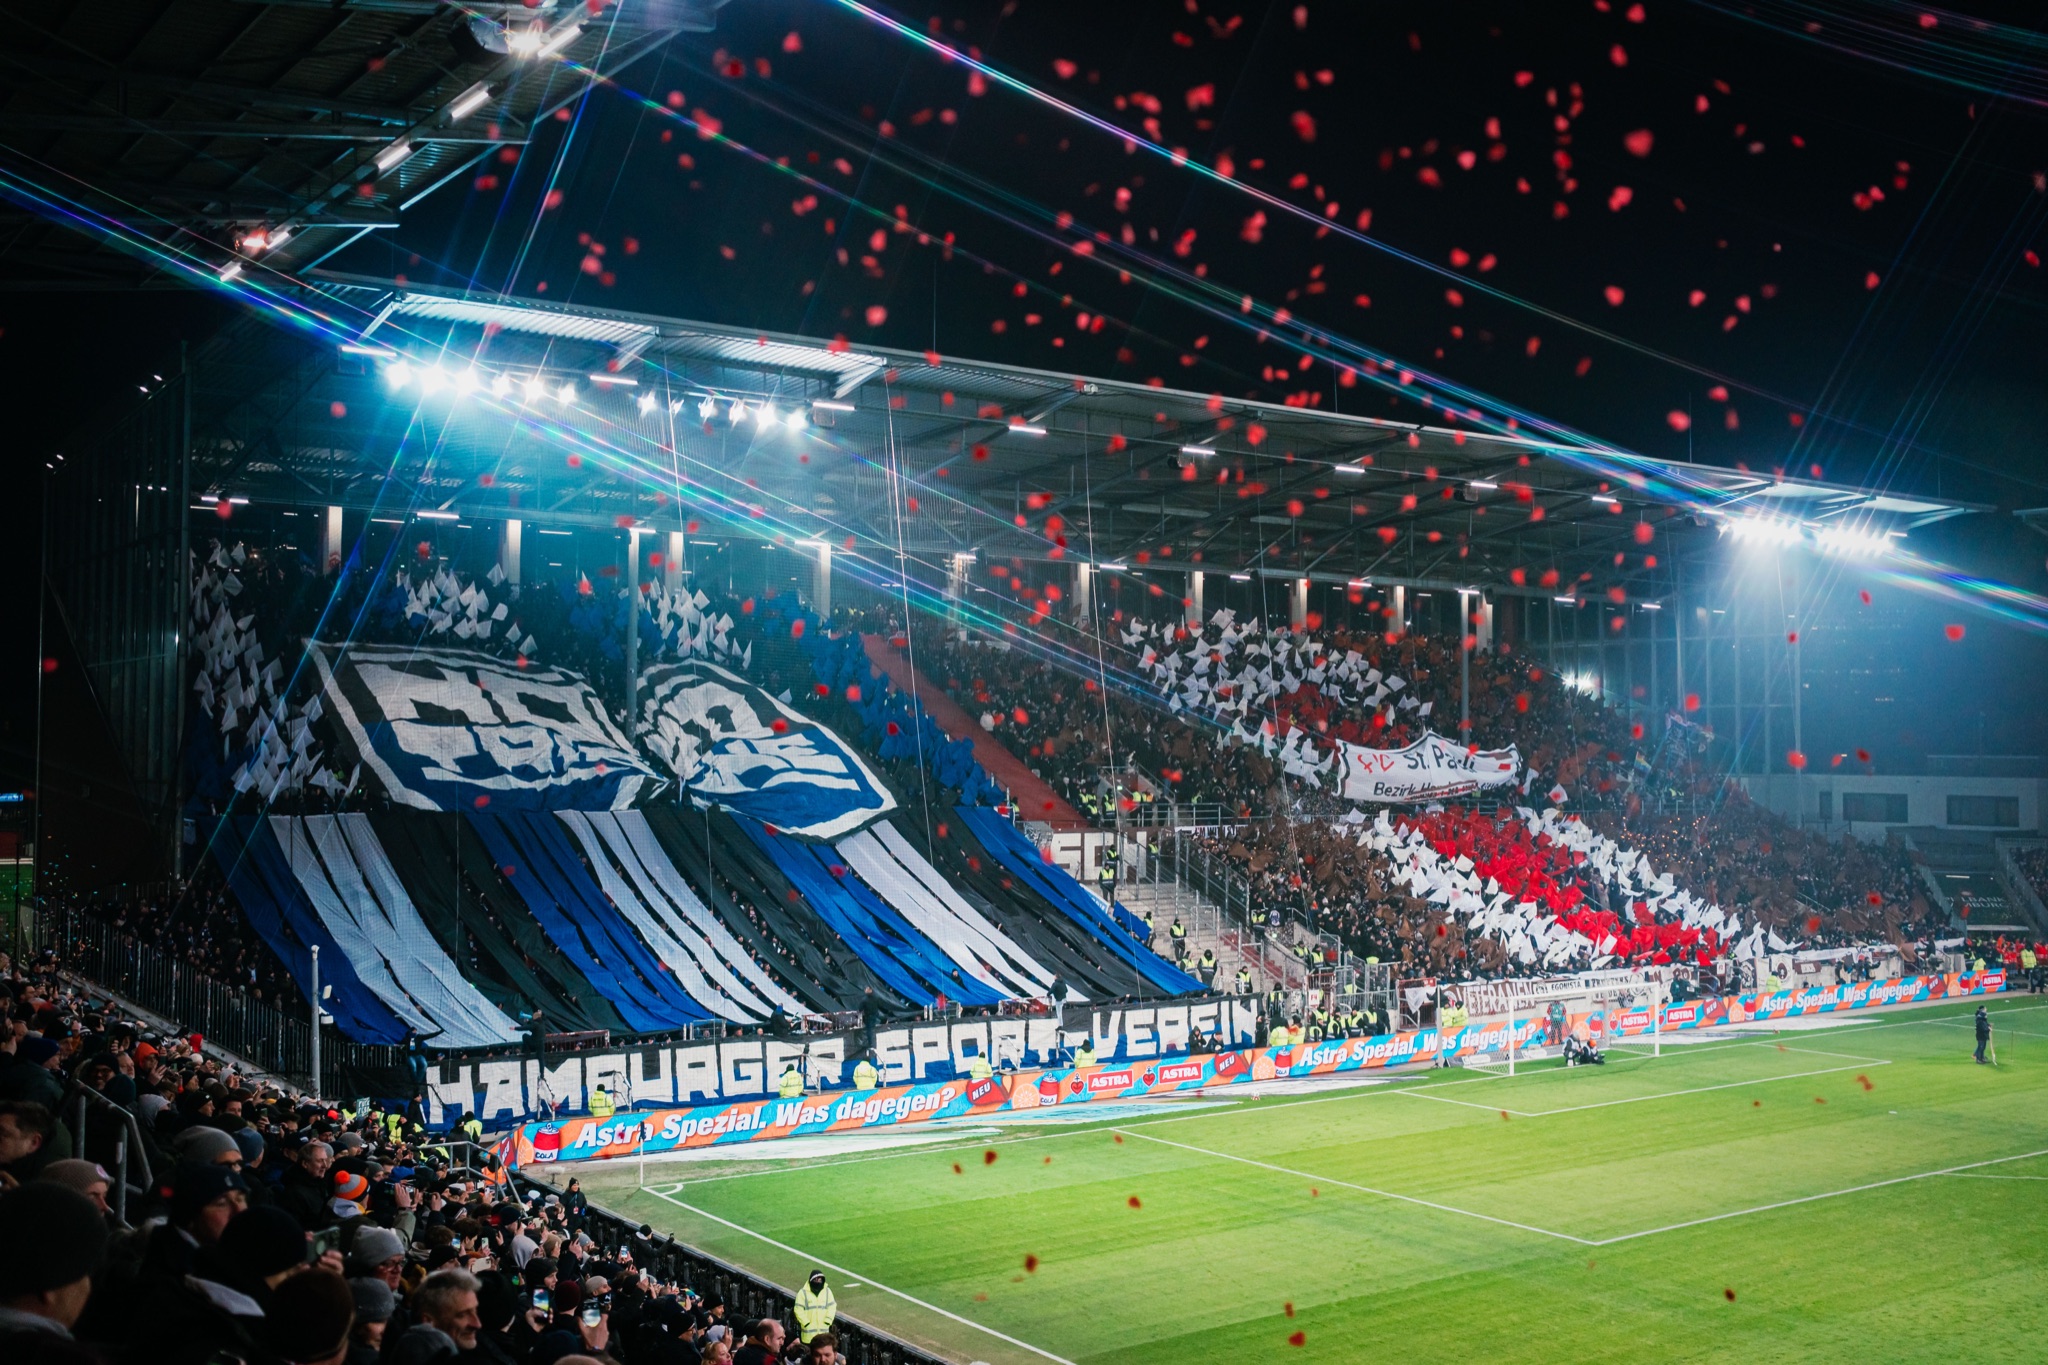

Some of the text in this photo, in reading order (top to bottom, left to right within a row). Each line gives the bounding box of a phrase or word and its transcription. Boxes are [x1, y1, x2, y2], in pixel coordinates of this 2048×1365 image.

[1760, 980, 1923, 1012] Astra Spezial. Was dagegen?
[1622, 1014, 1649, 1027] ASTRA
[1668, 1008, 1694, 1020] ASTRA
[1299, 1047, 1348, 1067] Astra
[1352, 1041, 1418, 1065] Spezial.
[1423, 1032, 1460, 1052] Was
[1219, 1055, 1235, 1072] NEU
[427, 1037, 845, 1125] HAMBURGER
[1091, 1074, 1130, 1089] ASTRA
[1161, 1067, 1200, 1080] ASTRA
[972, 1082, 991, 1101] NEU
[575, 1087, 955, 1149] Astra Spezial. Was dagegen?
[535, 1151, 554, 1159] COLA
